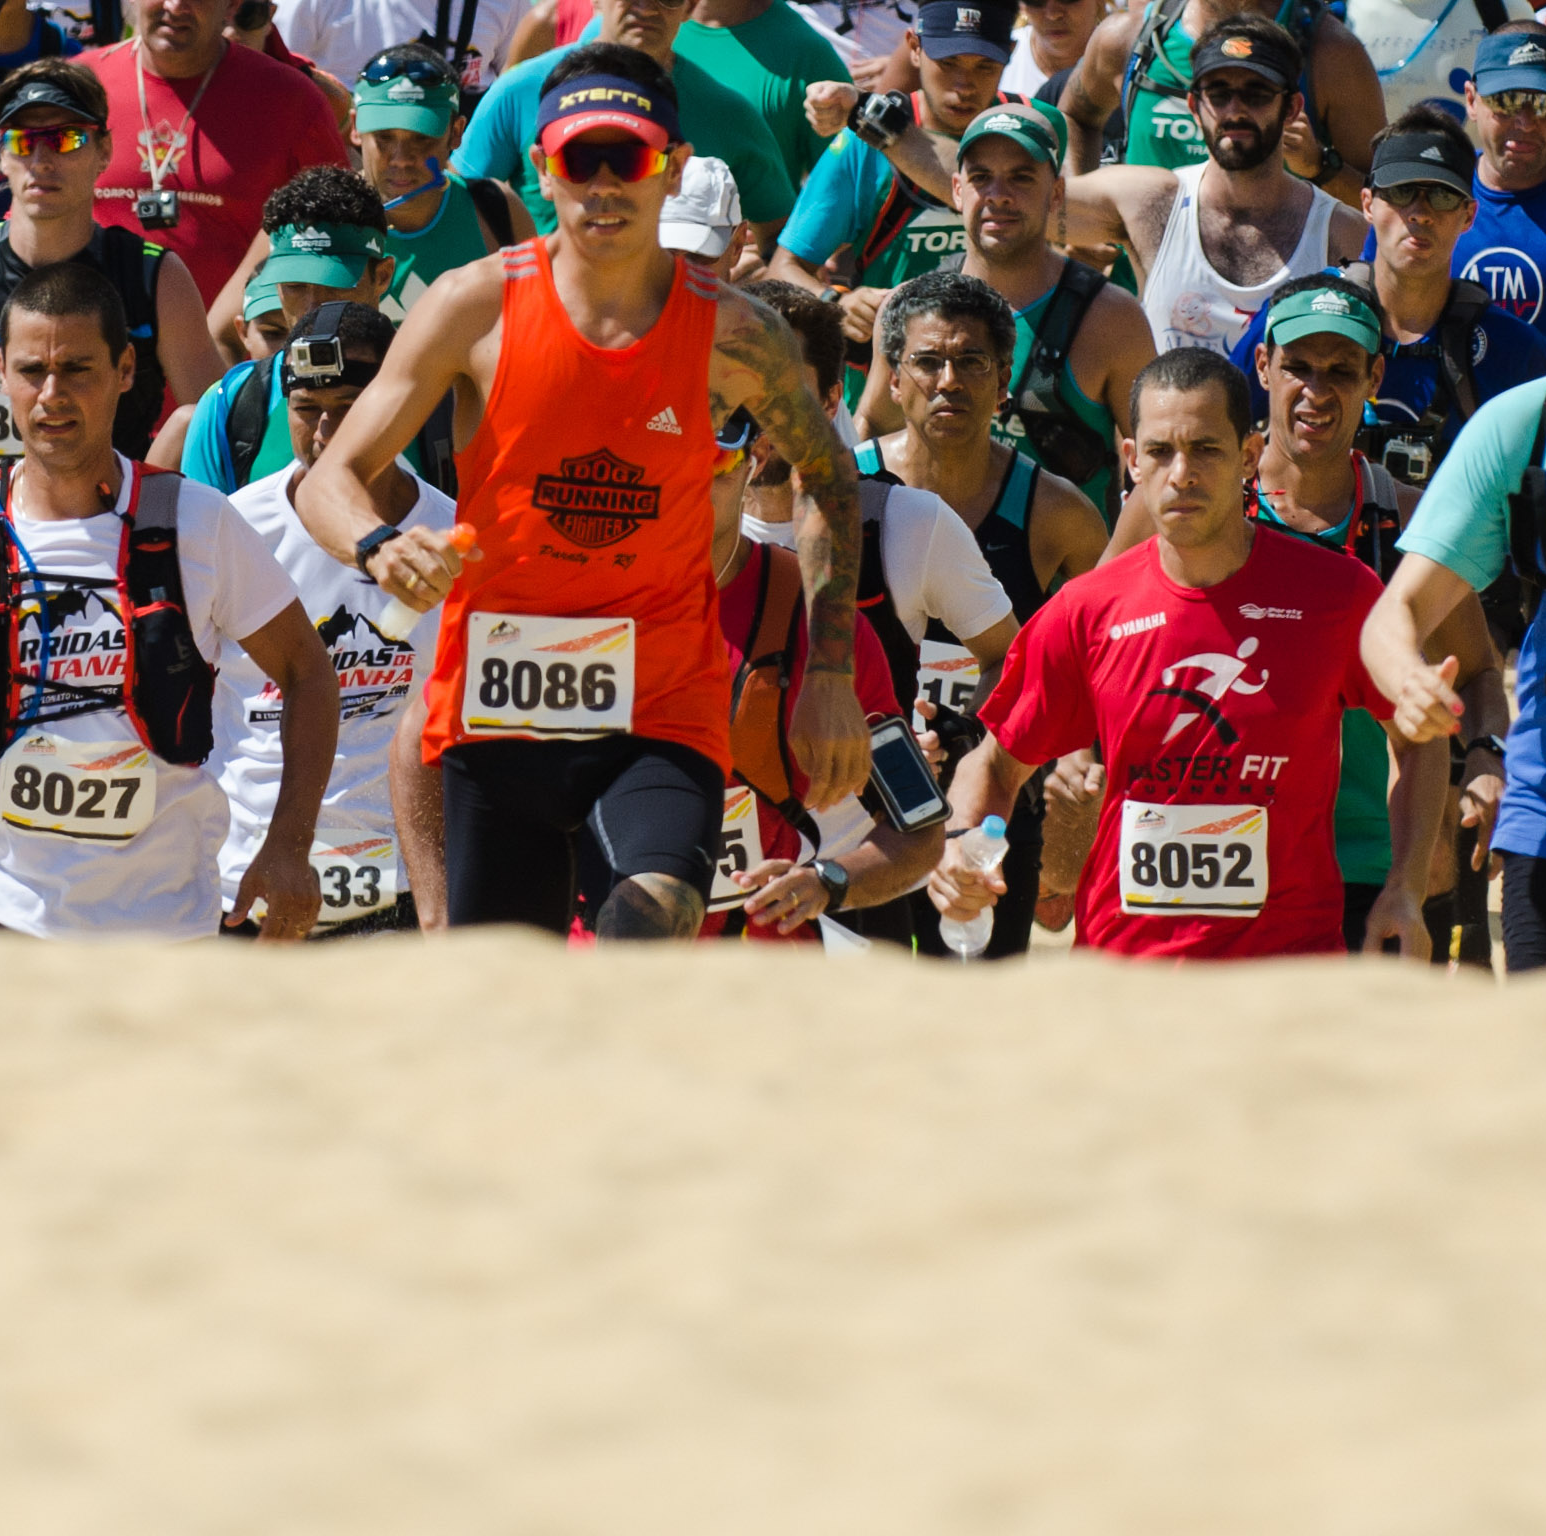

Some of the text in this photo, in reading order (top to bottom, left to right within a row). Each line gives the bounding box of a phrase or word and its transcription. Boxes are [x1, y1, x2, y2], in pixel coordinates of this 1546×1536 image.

[559, 88, 652, 112] XTERRA
[1152, 117, 1204, 142] TO
[646, 420, 683, 436] adidas
[574, 460, 630, 484] DOG
[542, 485, 652, 511] RUNNING
[1121, 612, 1167, 637] YAMAHA
[392, 653, 416, 667] DE
[479, 657, 618, 712] 8086
[1239, 755, 1289, 780] FIT
[11, 763, 141, 819] 8027
[1131, 841, 1255, 889] 8052
